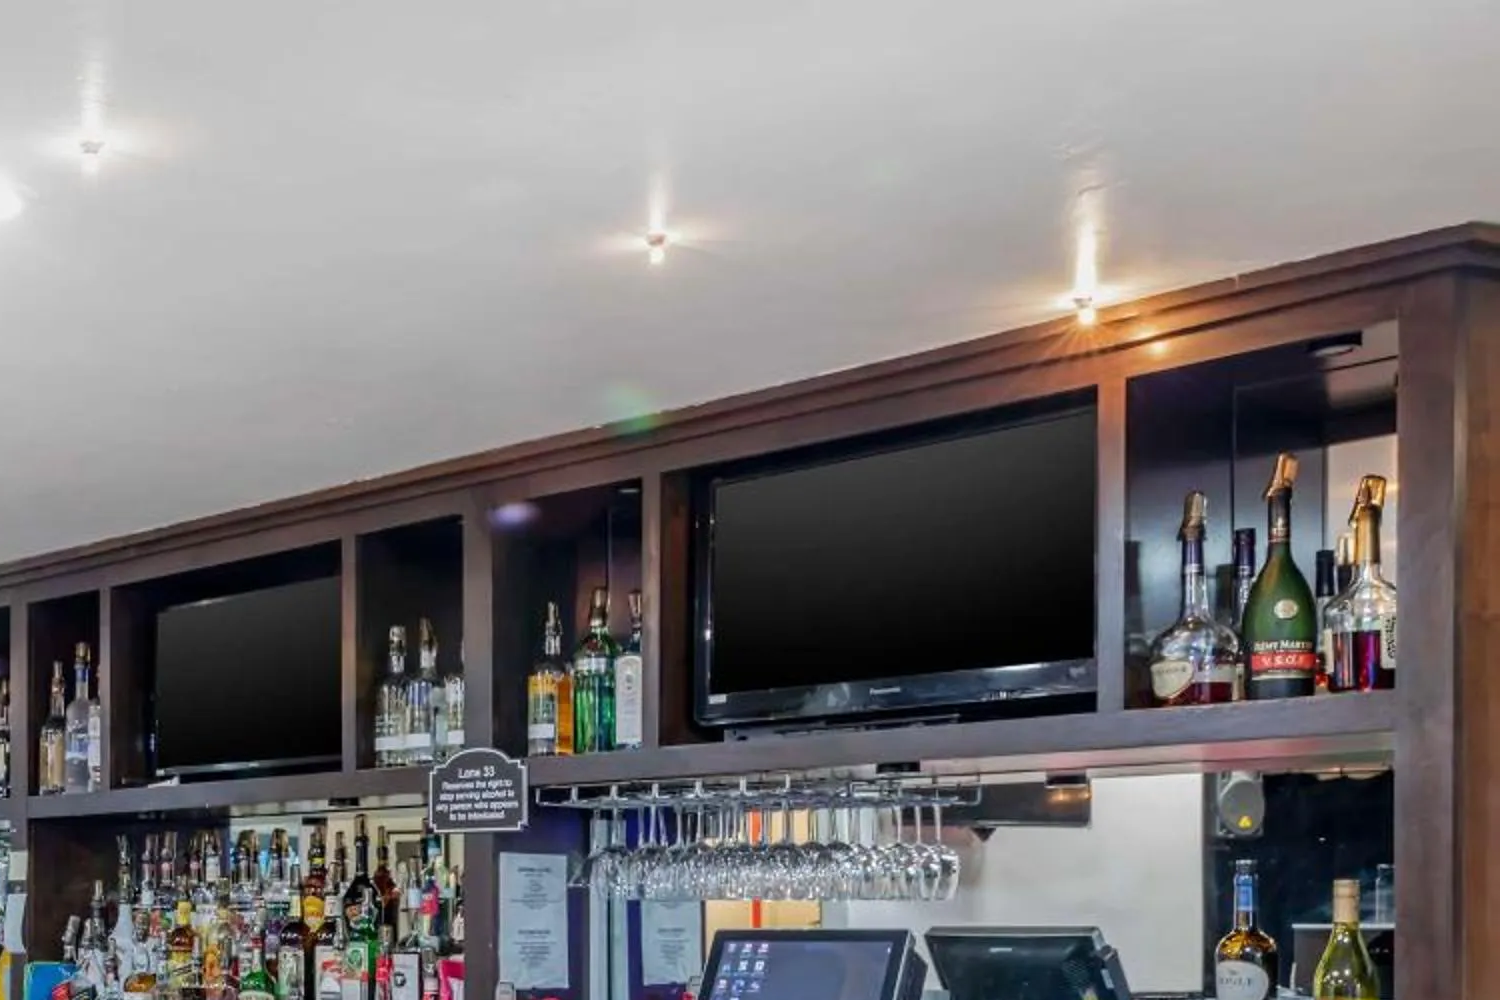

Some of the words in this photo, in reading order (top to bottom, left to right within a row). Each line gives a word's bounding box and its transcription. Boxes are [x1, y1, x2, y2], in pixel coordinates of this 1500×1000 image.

[458, 767, 481, 779] Lane
[483, 765, 496, 777] 33
[456, 792, 480, 801] serving
[482, 790, 506, 799] alcohol
[490, 801, 519, 812] appears
